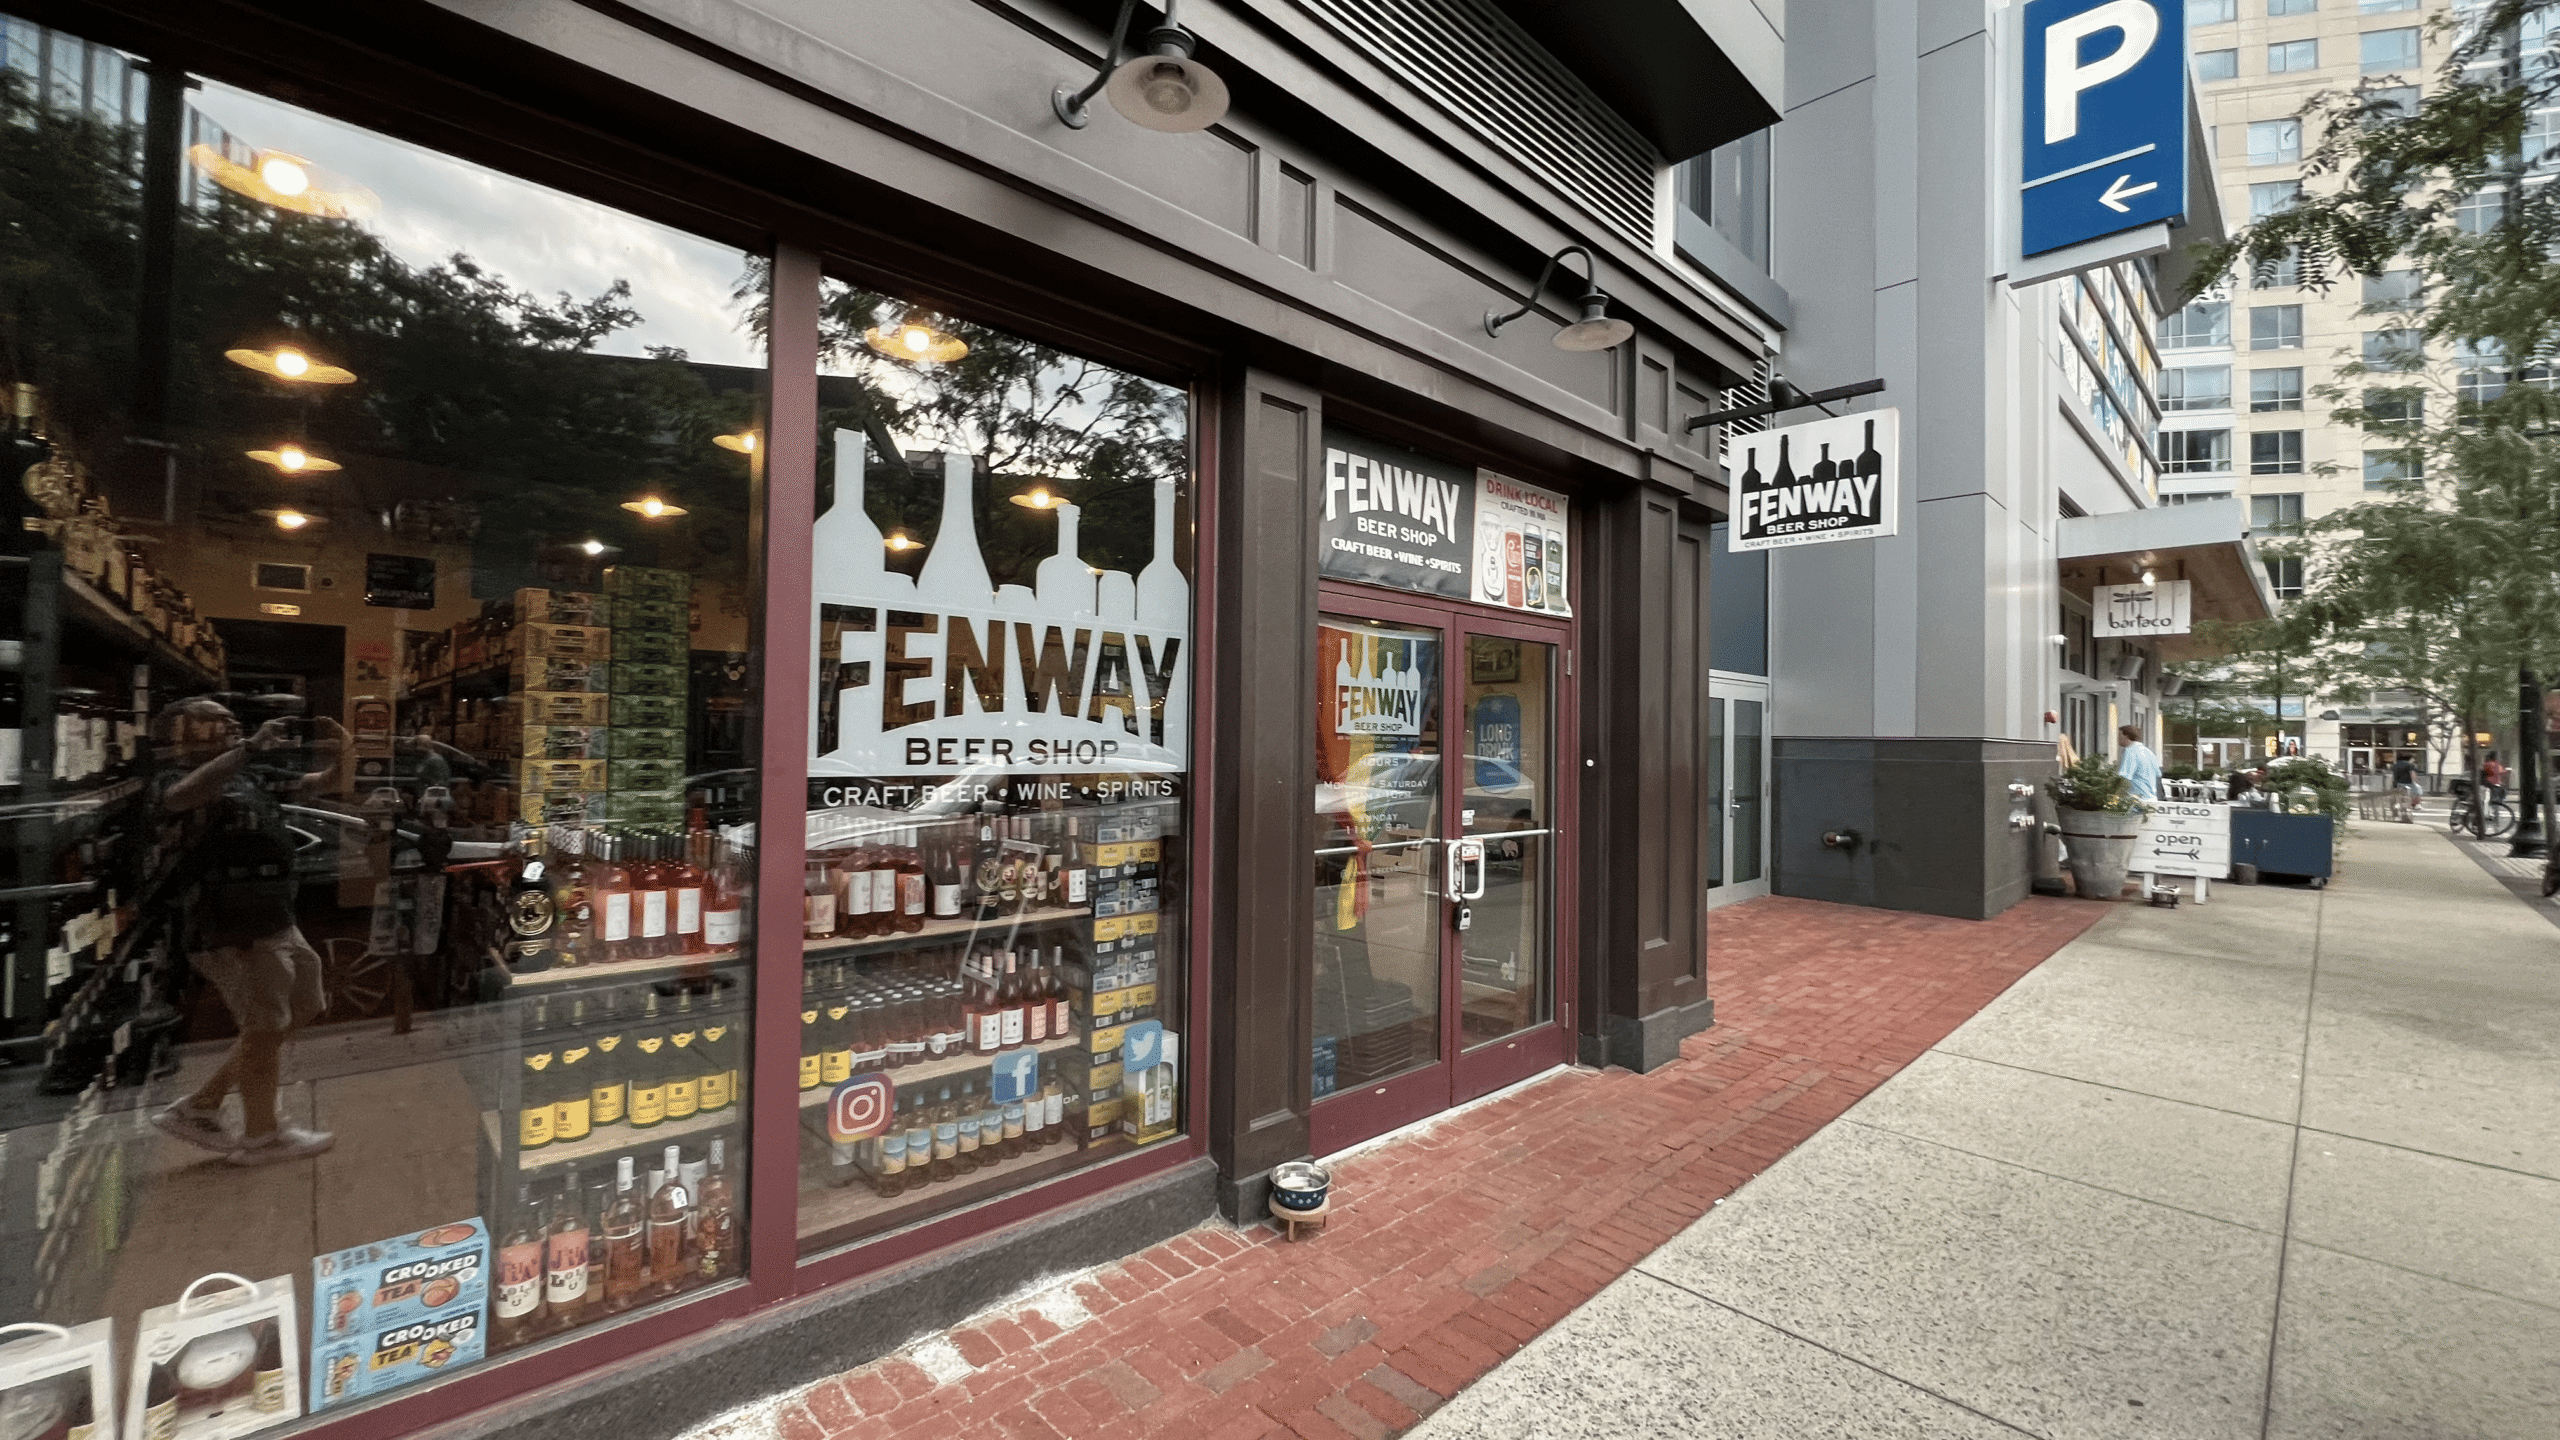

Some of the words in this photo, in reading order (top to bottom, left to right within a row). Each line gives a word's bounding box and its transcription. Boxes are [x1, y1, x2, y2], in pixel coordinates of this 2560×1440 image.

[2044, 0, 2159, 145] P
[1326, 447, 1460, 544] FENWAY
[1486, 479, 1523, 502] DRINK
[1524, 491, 1558, 514] LOCAL
[1742, 474, 1878, 536] FENWAY
[1357, 516, 1398, 539] BEER
[1400, 527, 1437, 547] SHOP
[1744, 540, 1772, 548] CRAFT
[1773, 537, 1795, 546] BEER
[1805, 533, 1827, 541] WINE
[1837, 528, 1874, 538] SPIRITS
[1766, 521, 1805, 535] BEER
[1808, 516, 1849, 530] SHOP
[1331, 537, 1366, 555] CRAFT
[1366, 544, 1393, 560] BEER
[1398, 551, 1424, 566] WINE
[1429, 557, 1461, 574] SPIRITS
[2108, 612, 2172, 629] bartaco
[817, 602, 1181, 759] FENWAY
[1338, 684, 1419, 727] FENWAY
[1354, 721, 1378, 731] BEER
[1380, 723, 1403, 731] SHOP
[1480, 723, 1512, 742] LONG
[905, 738, 1014, 765] BEER
[1028, 738, 1119, 766] SHOP
[823, 785, 914, 807] CRAFT
[922, 784, 989, 803] BEER
[1017, 782, 1072, 800] WINE
[1097, 780, 1173, 798] SPIRITS
[2155, 834, 2202, 846] open
[385, 1254, 477, 1283] CROOKED
[381, 1283, 416, 1302] TEA
[381, 1316, 474, 1347] CROOKED
[377, 1346, 413, 1366] TEA
